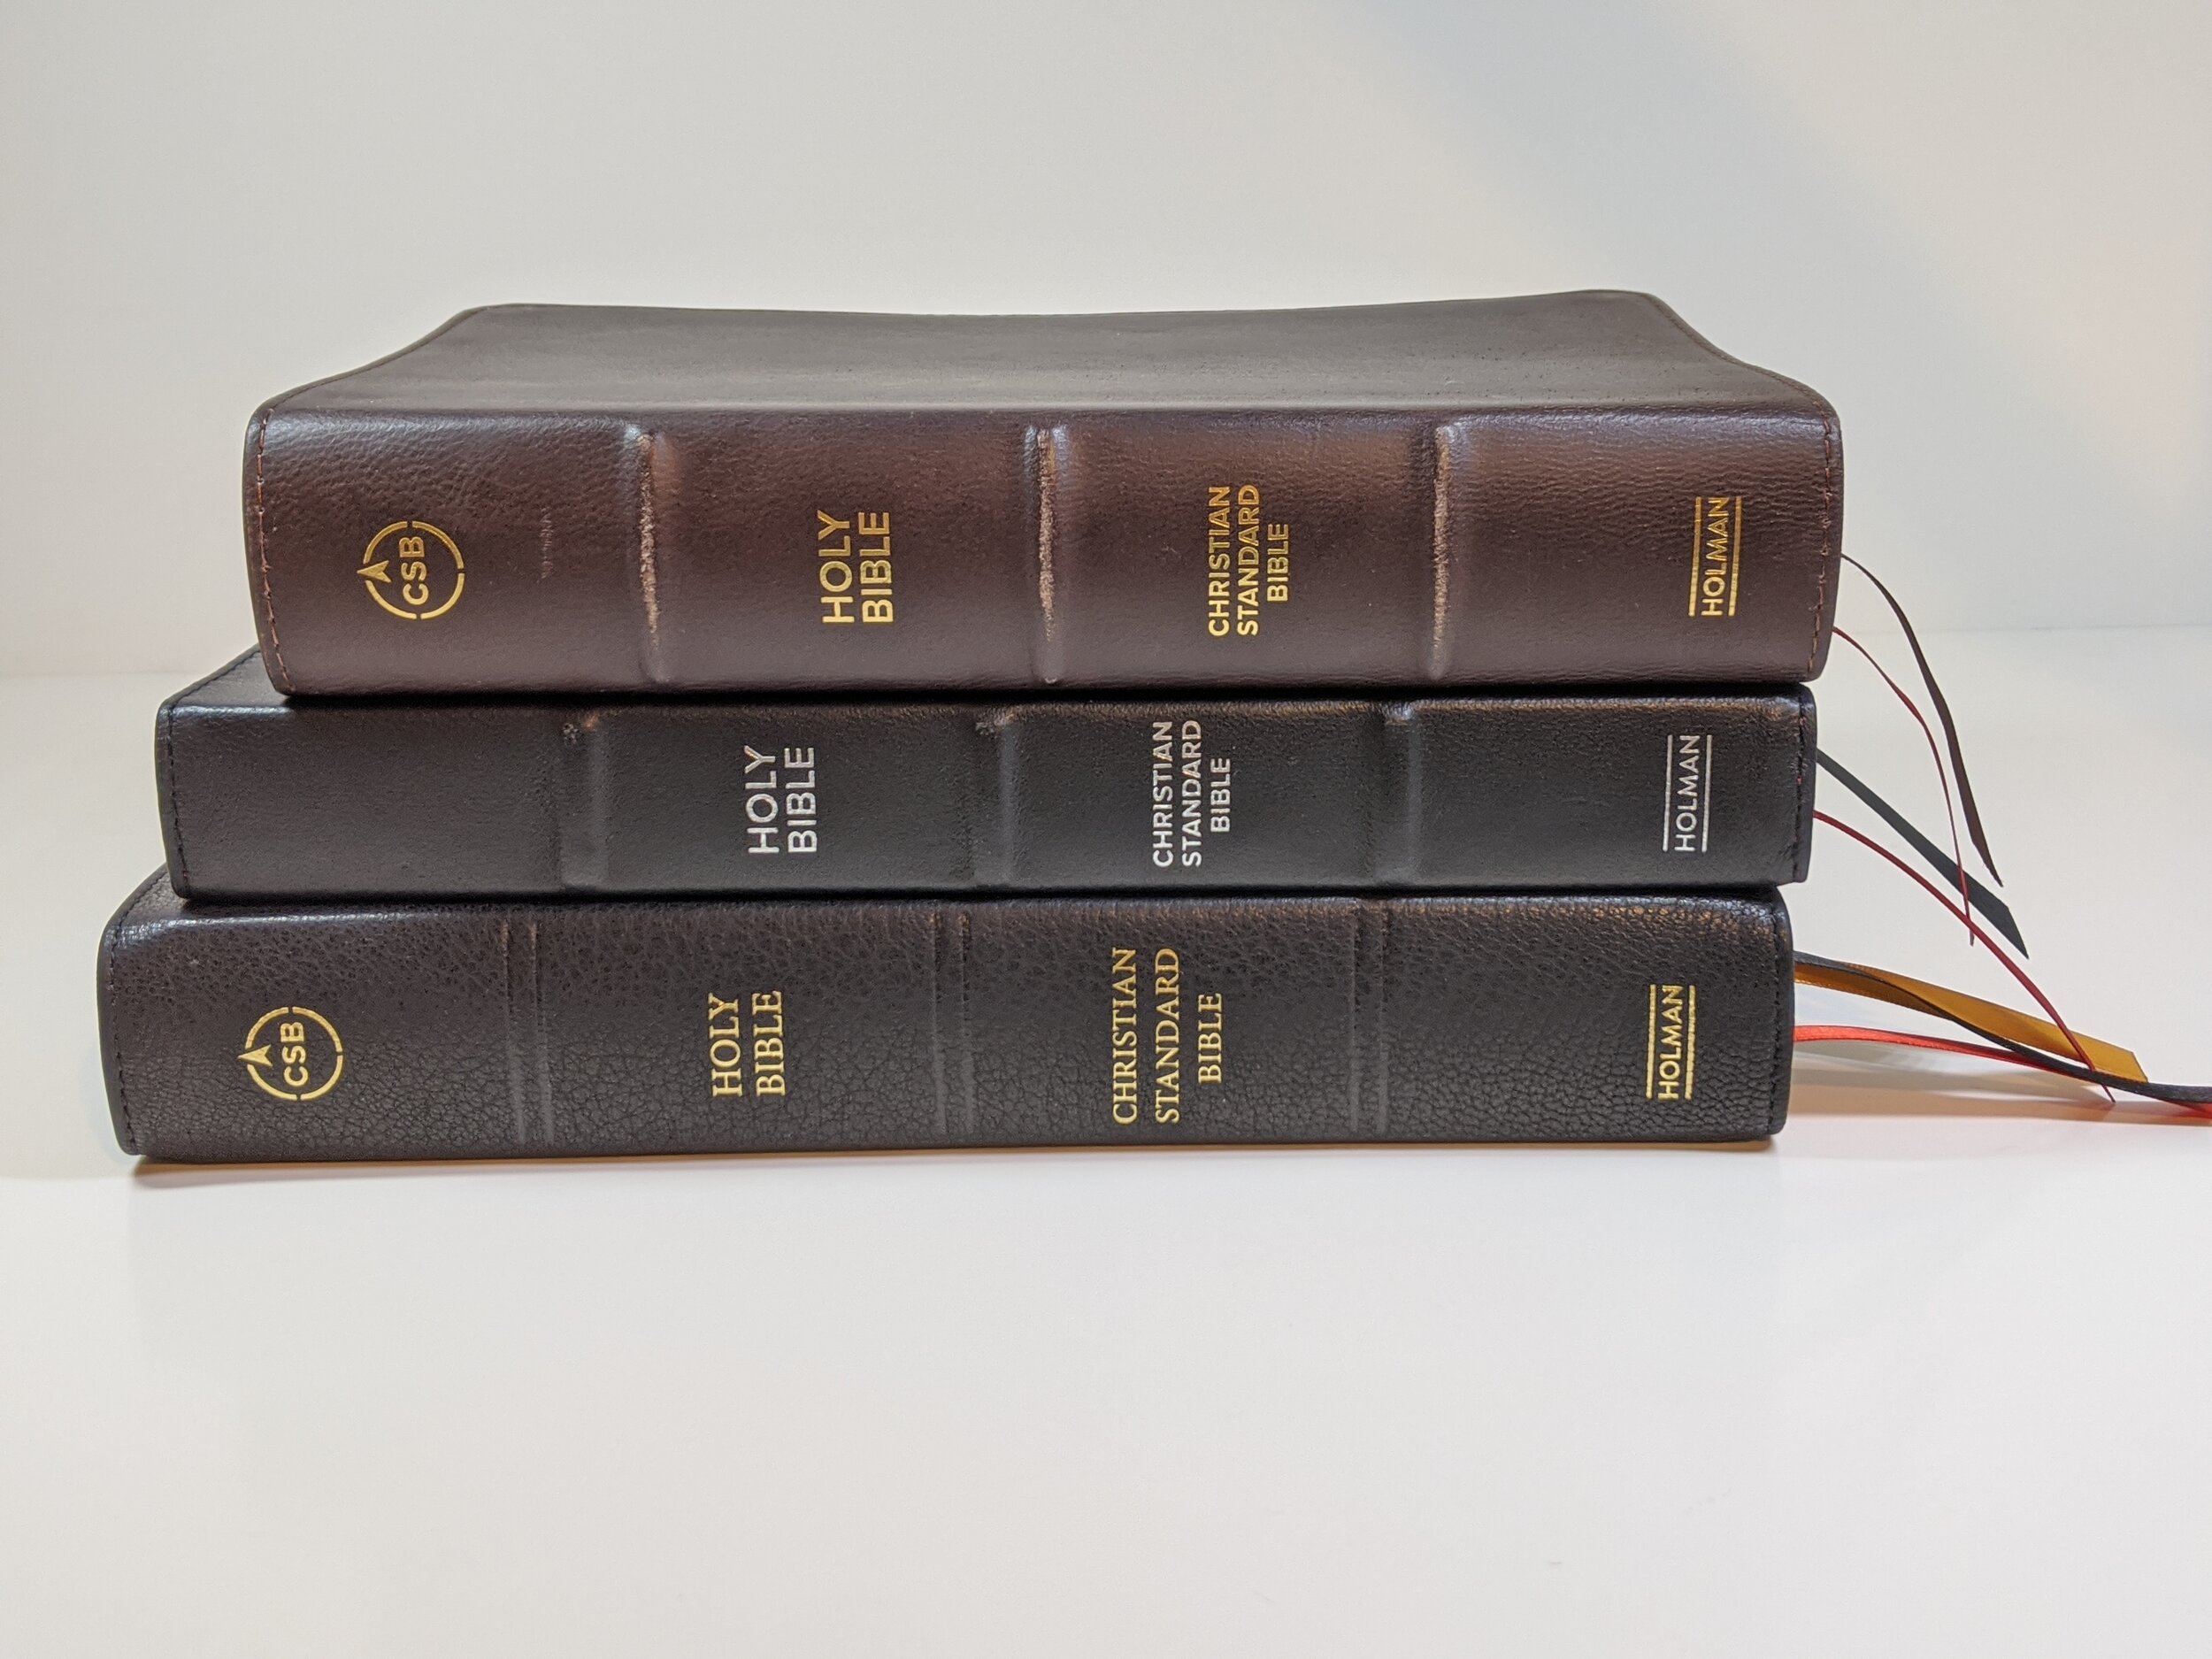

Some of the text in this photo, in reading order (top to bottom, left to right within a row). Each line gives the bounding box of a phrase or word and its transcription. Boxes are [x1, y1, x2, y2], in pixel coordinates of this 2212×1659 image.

[399, 535, 430, 607] CSB
[817, 509, 853, 625] HOLY
[857, 511, 895, 624] BIBLE
[1207, 486, 1231, 638] CHRISTIAN
[1235, 484, 1260, 637] STANDARD
[1266, 523, 1289, 603] BIBLE
[1700, 496, 1731, 618] HOLMAN
[744, 745, 780, 855] HOLY
[784, 747, 818, 855] BIBLE
[1151, 721, 1174, 868] CHRISTIAN
[1180, 720, 1202, 868] STANDARD
[1210, 757, 1231, 833] BIBLE
[1673, 734, 1701, 852] HOLMAN
[280, 1021, 310, 1088] CSB
[708, 994, 743, 1097] HOLY
[751, 990, 787, 1096] BIBLE
[1111, 948, 1138, 1125] CHRISTIAN
[1155, 948, 1180, 1124] STANDARD
[1197, 994, 1222, 1084] BIBLE
[1657, 985, 1684, 1101] HOLMAN
